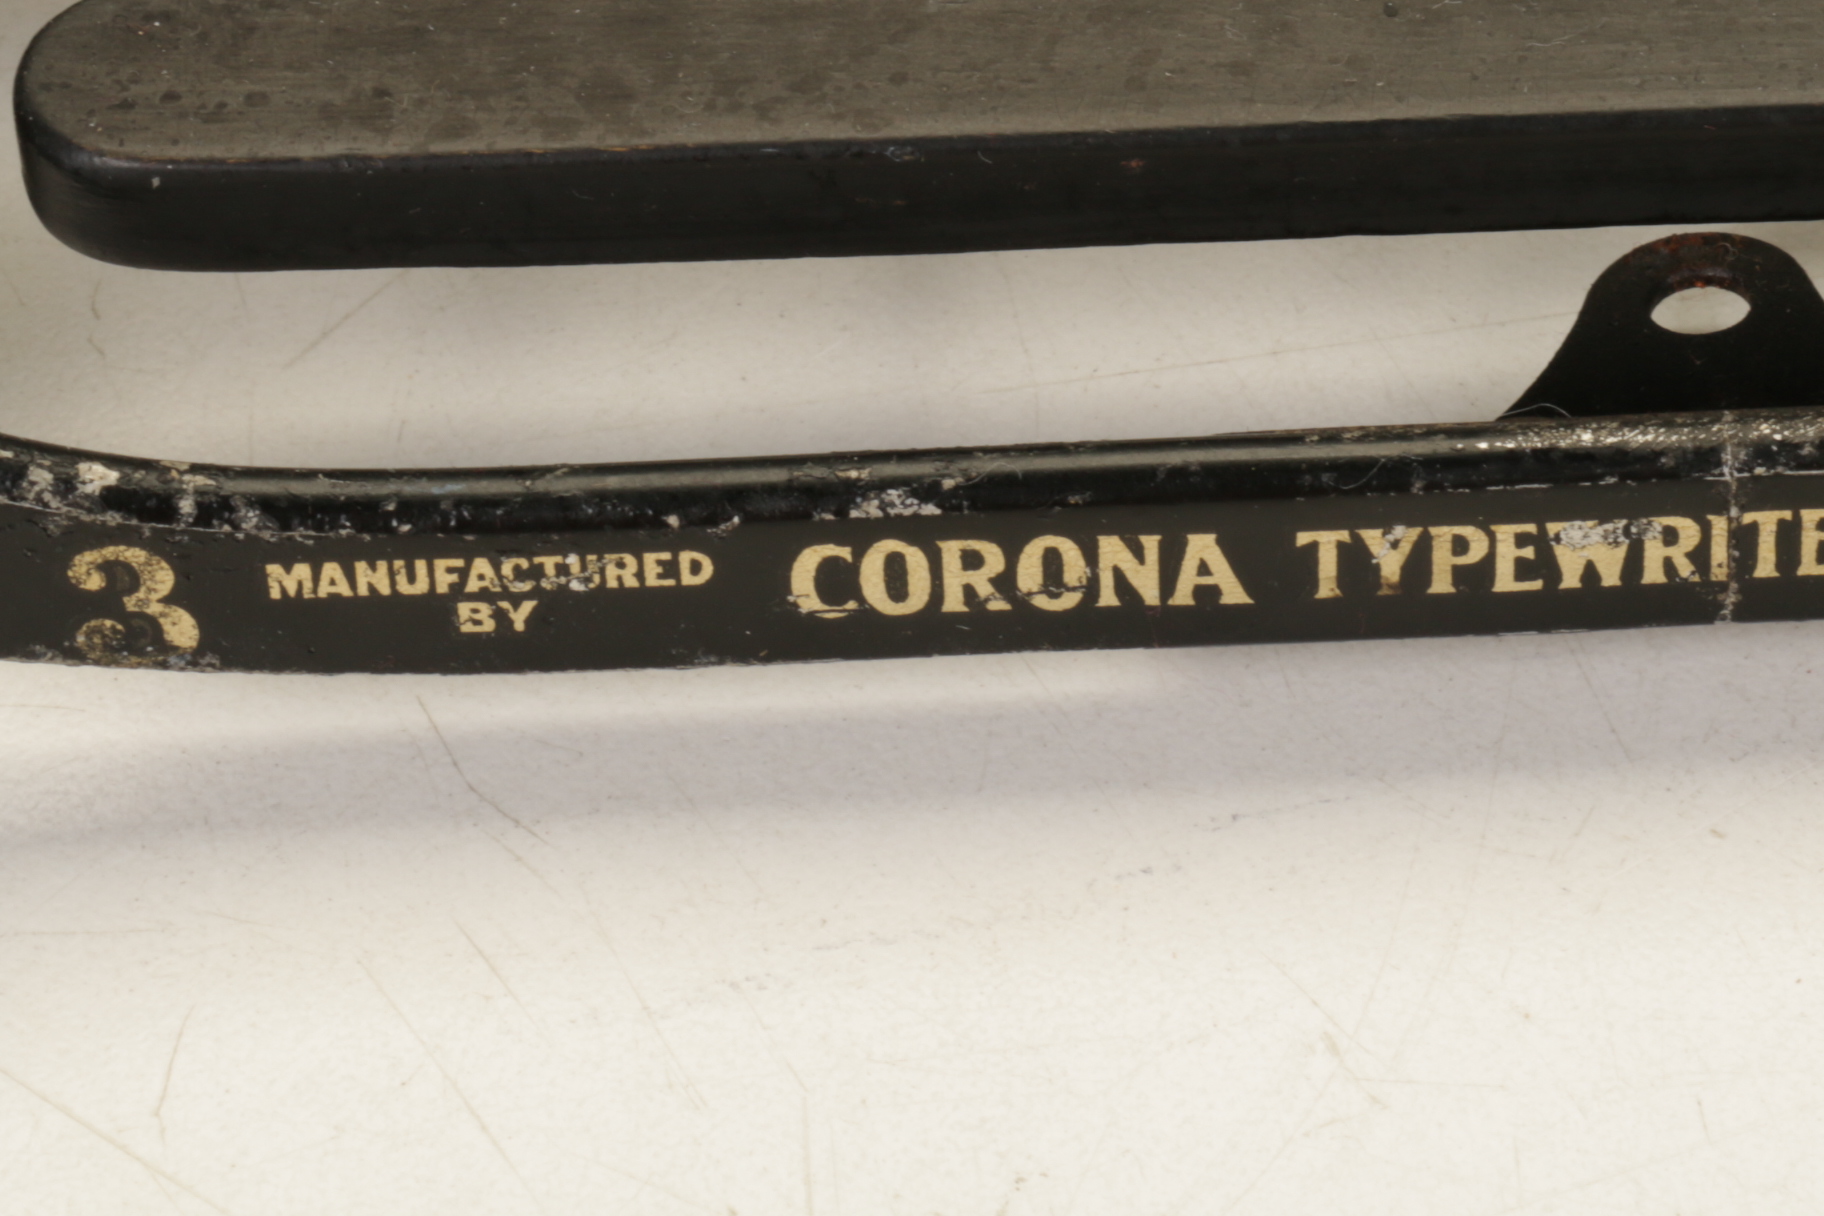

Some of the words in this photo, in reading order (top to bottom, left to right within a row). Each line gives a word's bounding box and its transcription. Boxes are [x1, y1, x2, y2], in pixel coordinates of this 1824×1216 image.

[67, 545, 200, 660] 3
[265, 549, 714, 600] MANUFACTURED
[788, 534, 1256, 619] CORONA
[457, 599, 539, 634] BY
